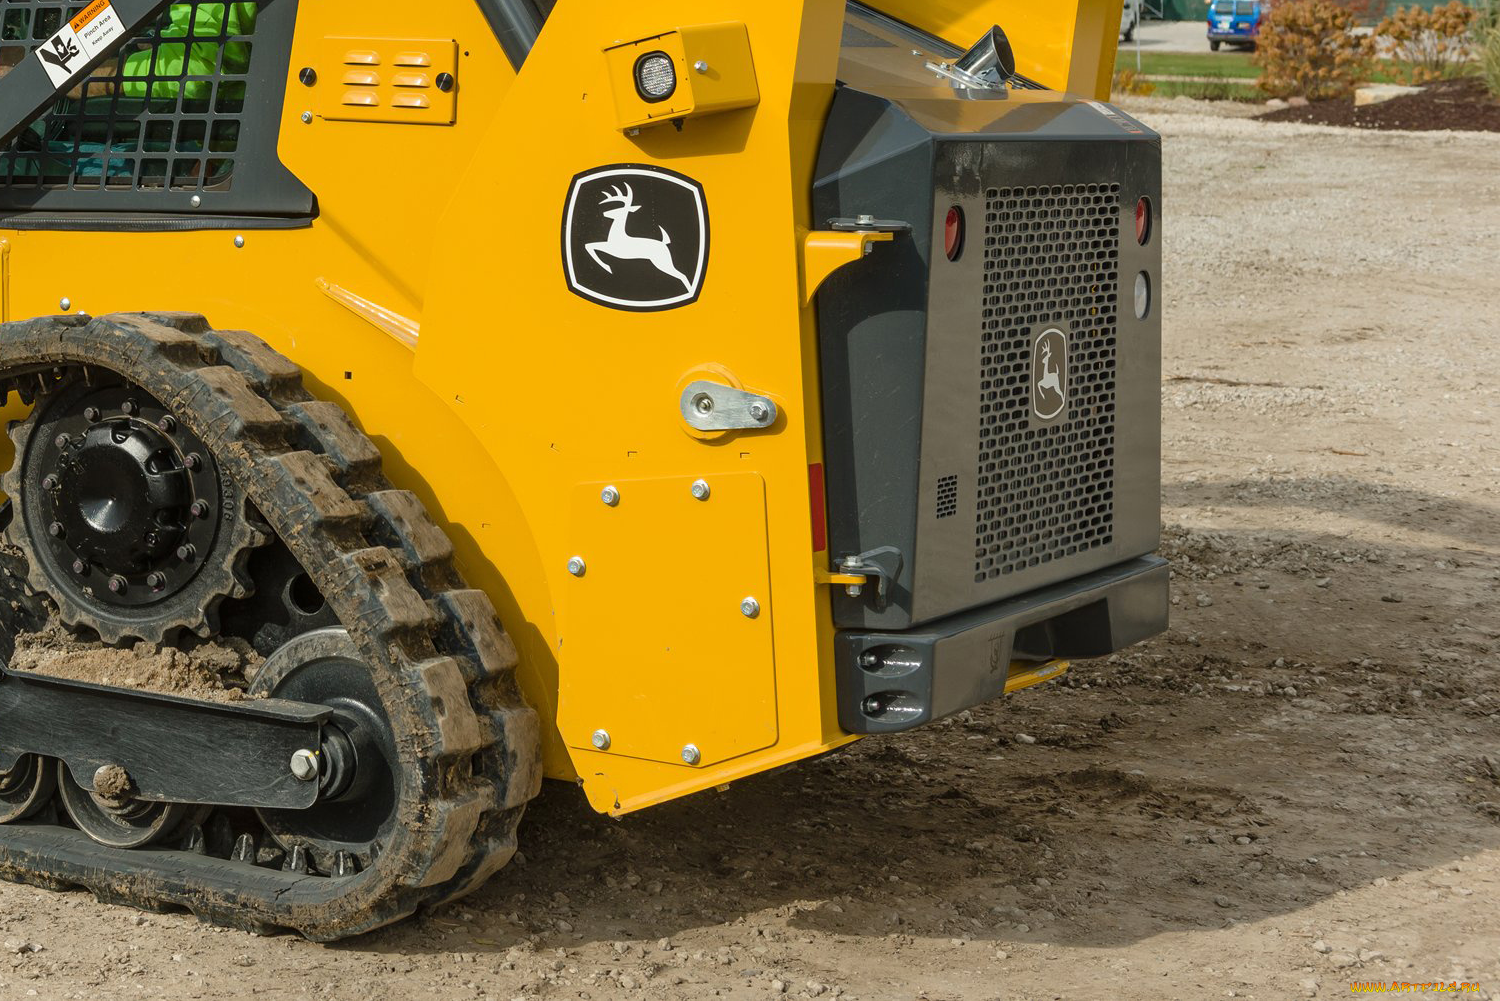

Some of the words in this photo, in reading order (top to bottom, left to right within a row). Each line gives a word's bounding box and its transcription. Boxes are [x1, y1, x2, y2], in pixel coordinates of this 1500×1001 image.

[79, 0, 105, 24] WARNING
[84, 25, 99, 39] Pinch
[99, 15, 111, 27] Area
[92, 36, 102, 46] Keep
[103, 27, 114, 36] Away
